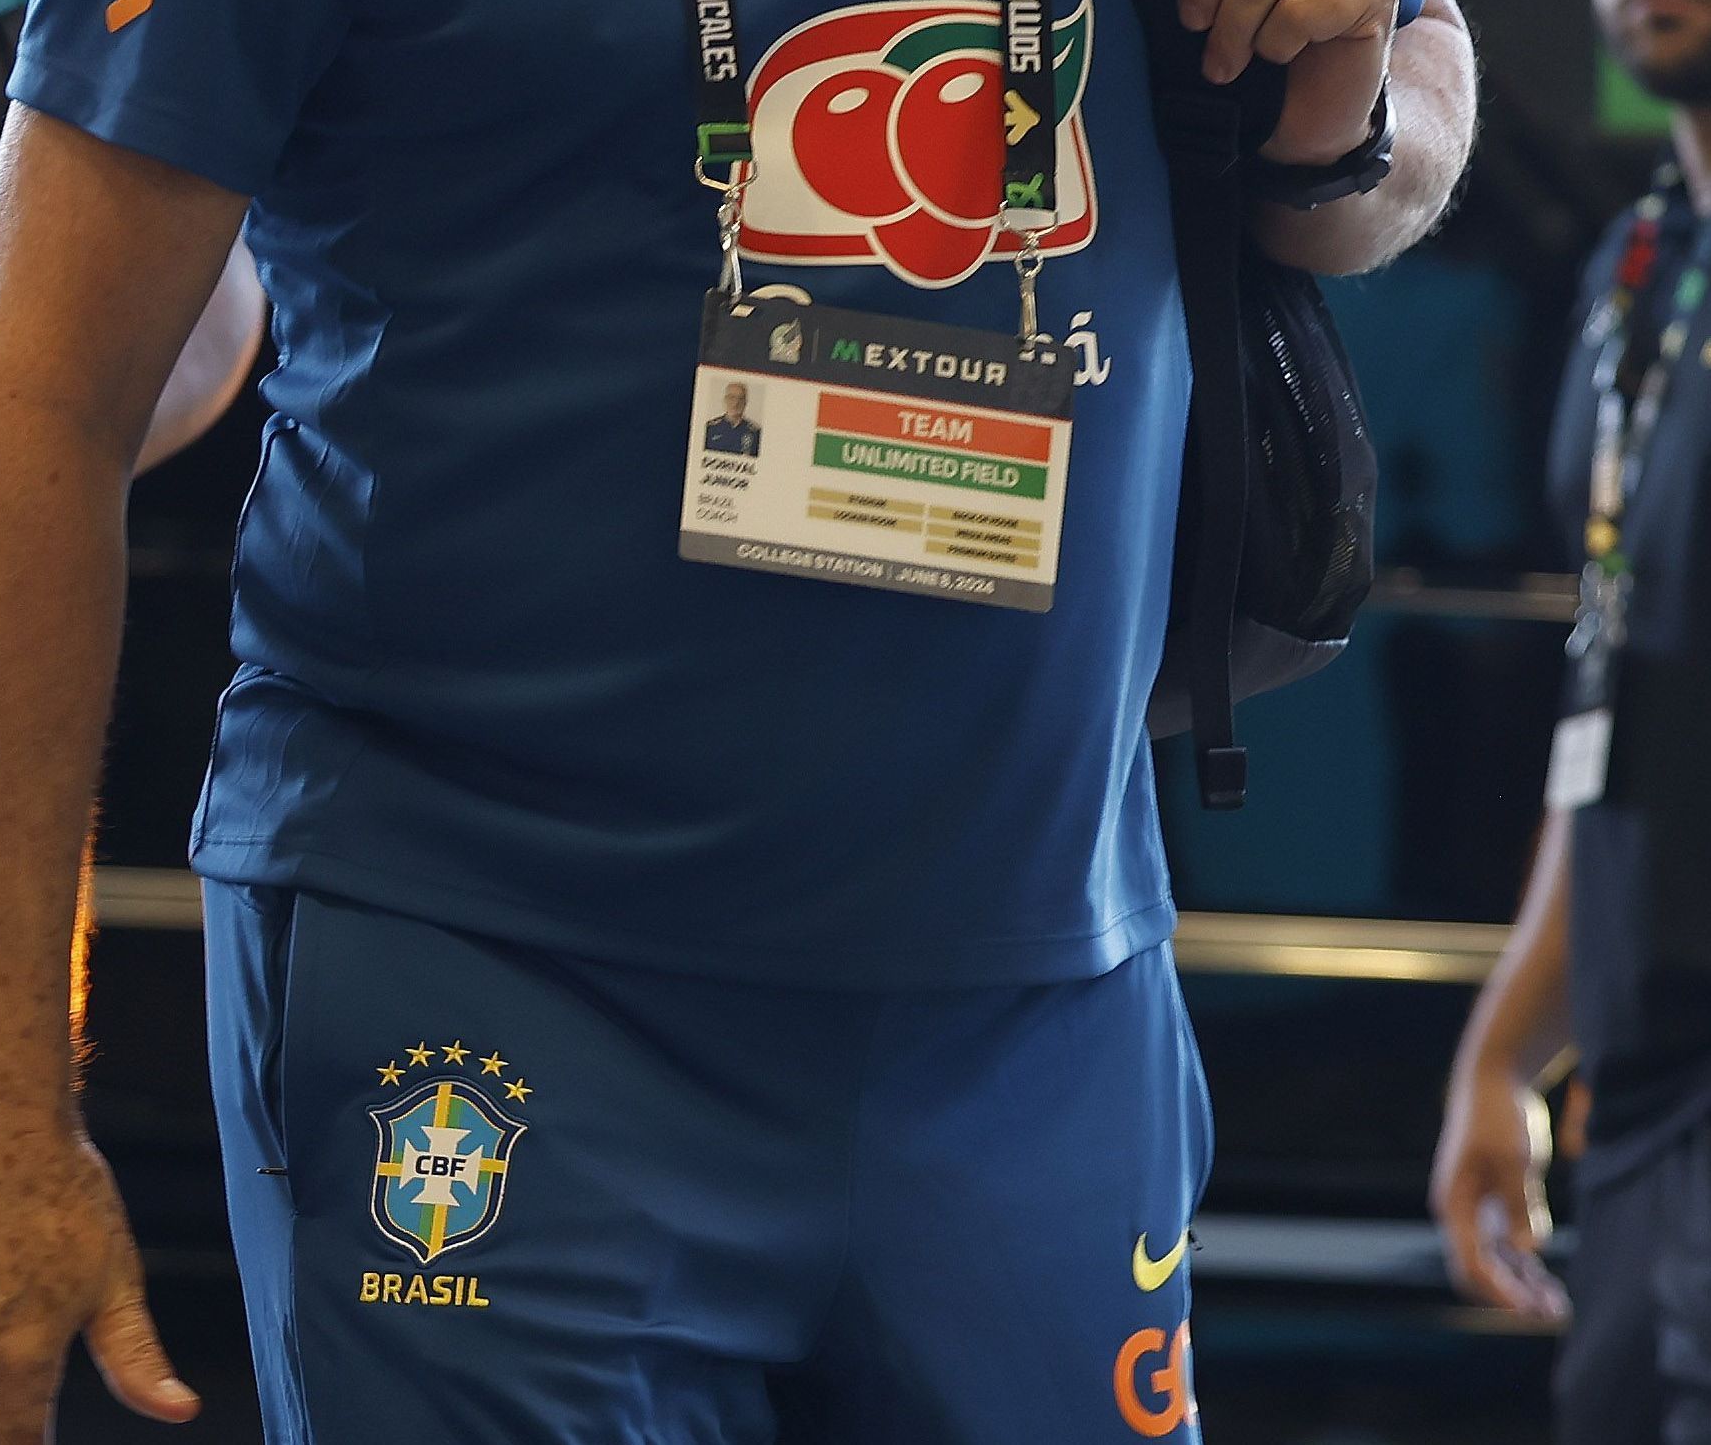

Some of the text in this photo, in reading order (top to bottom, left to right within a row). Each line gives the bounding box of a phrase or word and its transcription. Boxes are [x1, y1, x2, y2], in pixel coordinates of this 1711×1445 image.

[829, 338, 1008, 387] MEXTOUR
[897, 410, 973, 444] TEAM
[842, 441, 1021, 489] UNLIMITED FIELD
[415, 1155, 467, 1178] CBF
[359, 1272, 490, 1307] BRASIL
